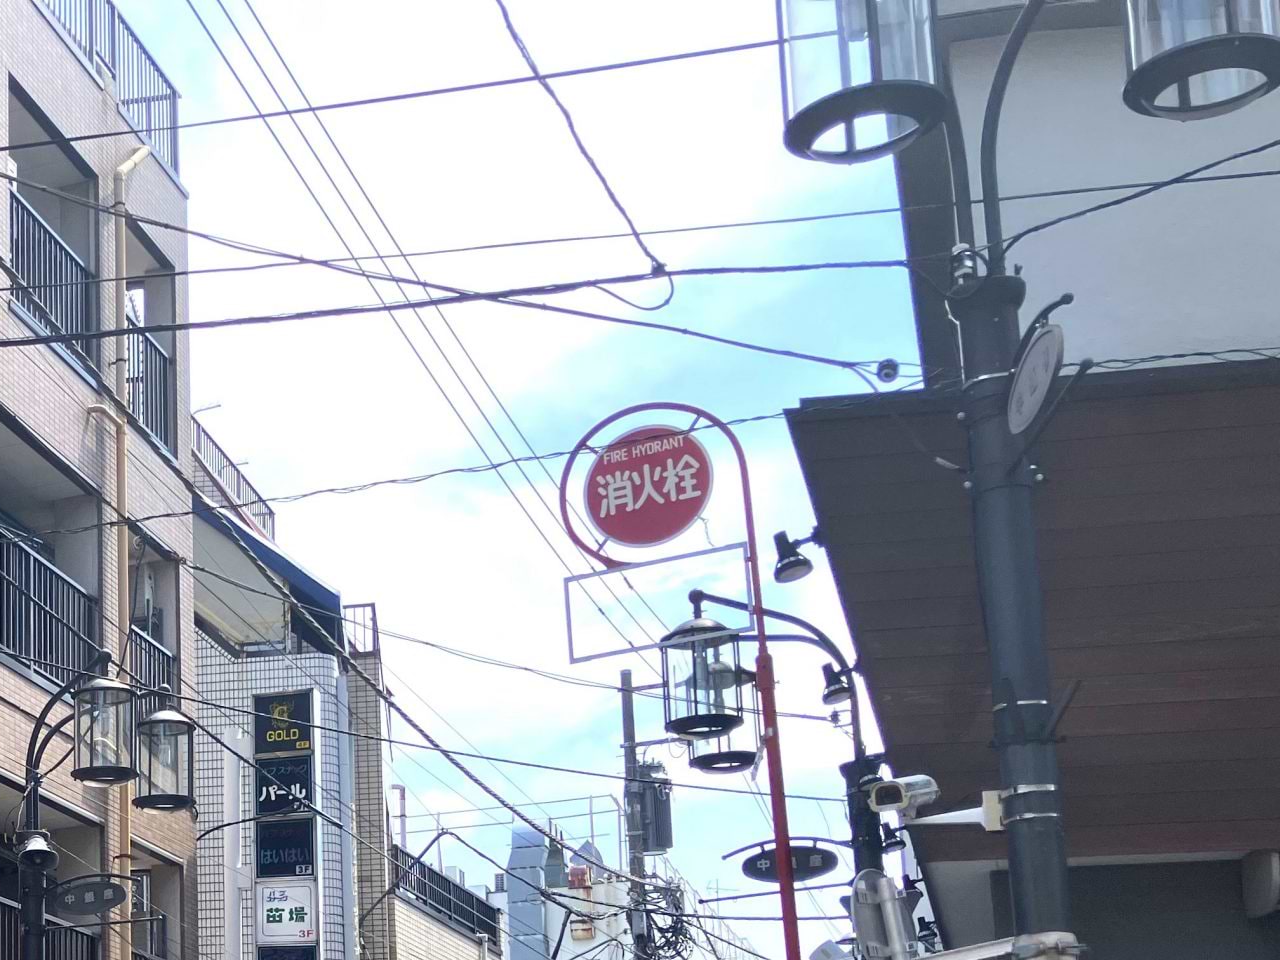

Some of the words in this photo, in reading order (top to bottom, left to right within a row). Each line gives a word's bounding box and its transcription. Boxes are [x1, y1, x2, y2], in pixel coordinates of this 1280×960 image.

[603, 448, 629, 465] FIRE
[632, 435, 685, 458] HYDRANT
[596, 455, 702, 518] 消火栓
[266, 729, 299, 742] GOLD
[259, 783, 307, 801] パール
[297, 866, 310, 874] 3F
[298, 929, 314, 938] 3F
